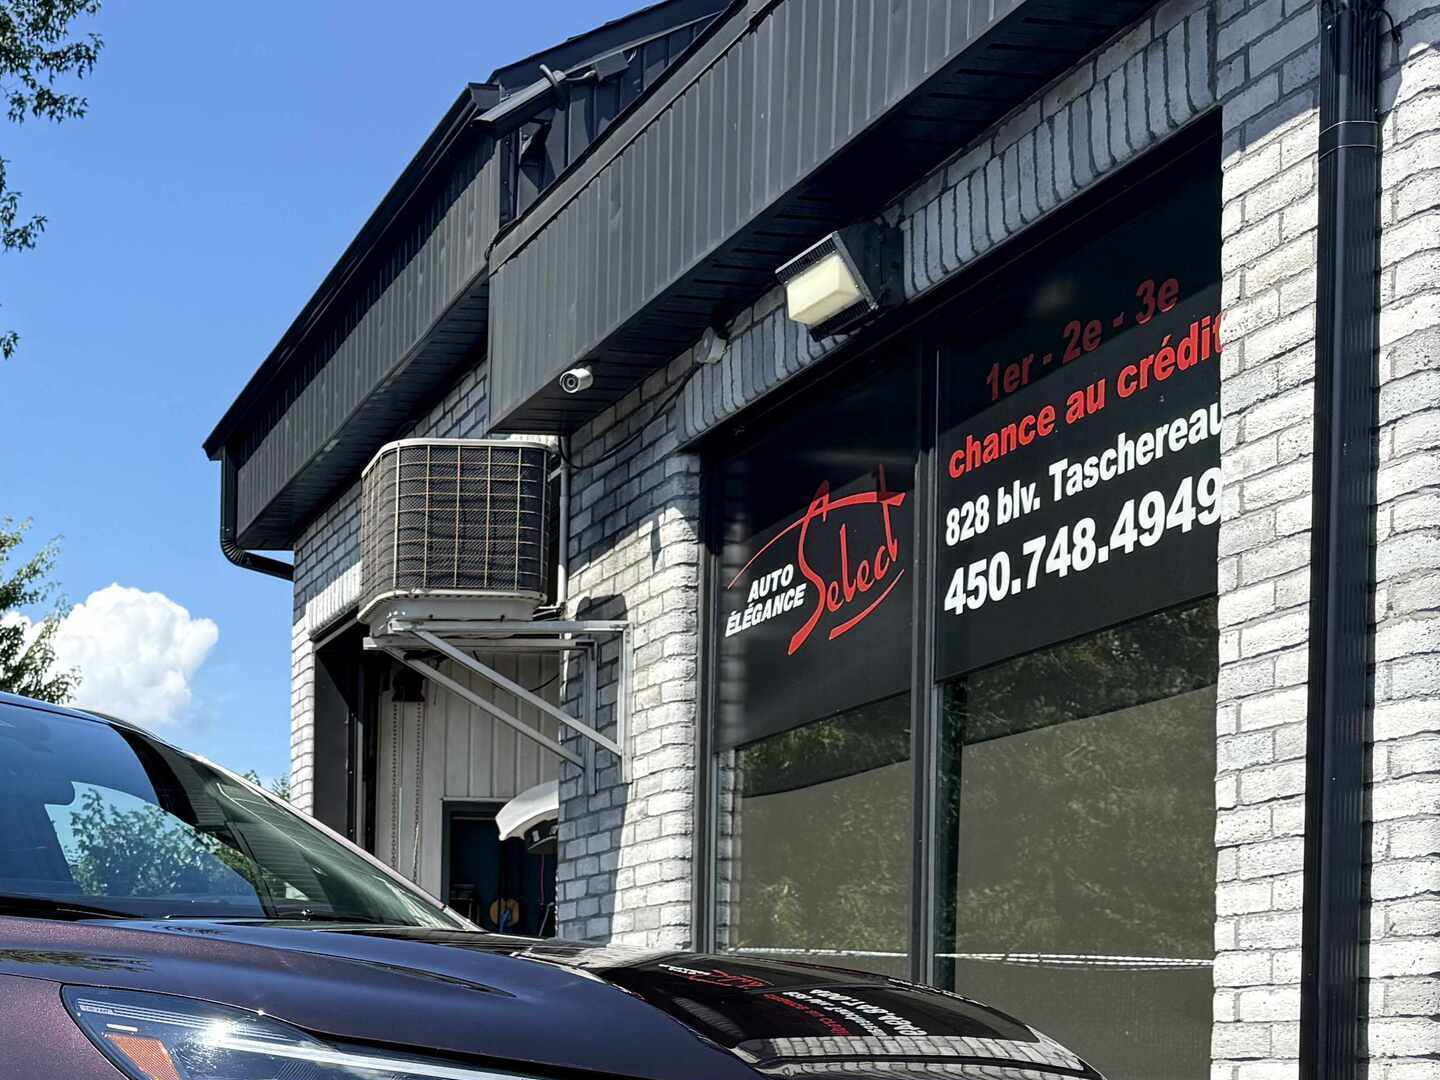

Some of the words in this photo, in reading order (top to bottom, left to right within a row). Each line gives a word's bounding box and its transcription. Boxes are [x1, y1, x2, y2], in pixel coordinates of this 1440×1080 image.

[985, 353, 1035, 401] 1er
[1061, 318, 1103, 365] 2e
[1134, 277, 1180, 326] 3e
[948, 404, 1057, 479] chance
[1065, 376, 1107, 425] au
[788, 464, 906, 656] Select
[944, 466, 1223, 616] 450.748.4949
[945, 494, 990, 547] 828
[996, 479, 1041, 526] blv.
[725, 582, 808, 638] ÉLÉGANCE
[747, 563, 795, 603] AUTO
